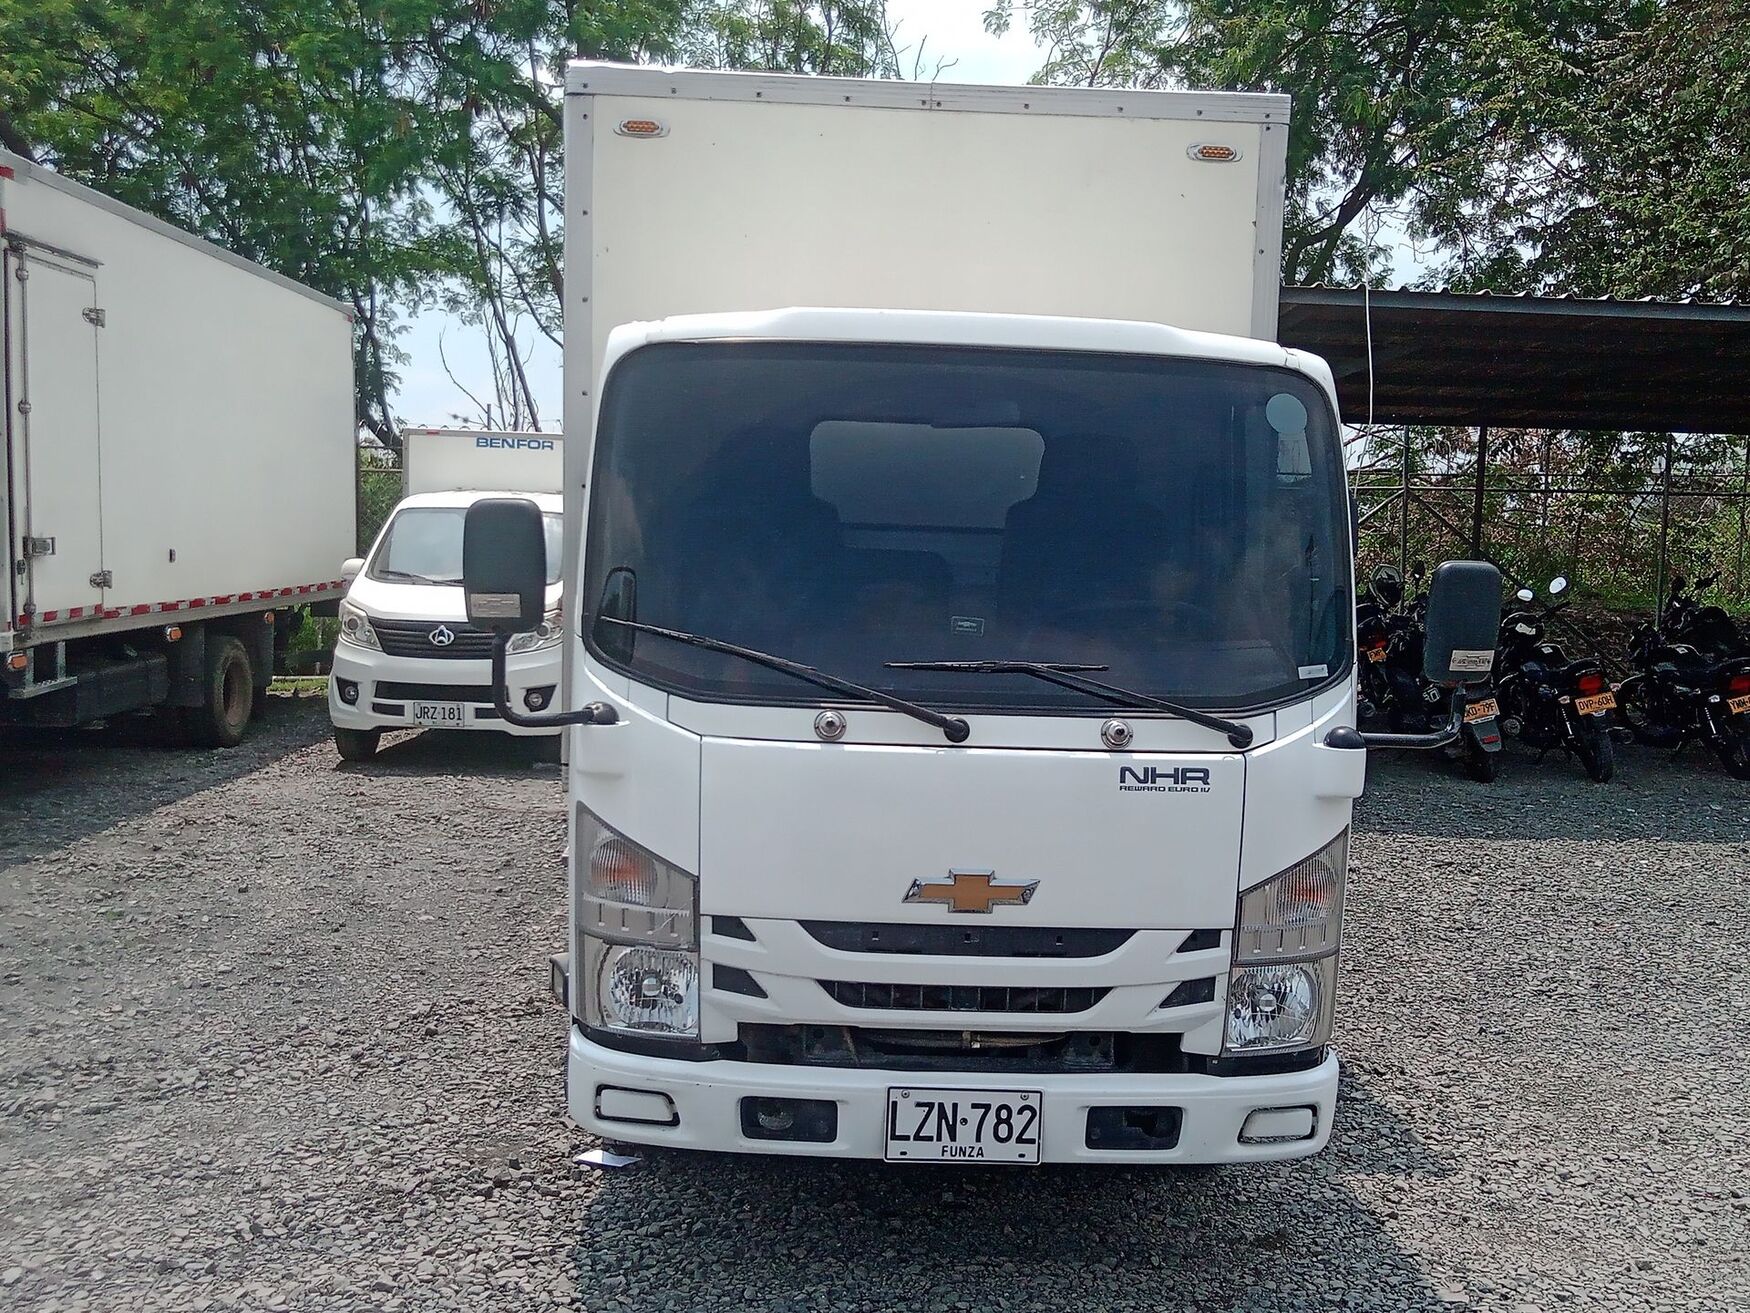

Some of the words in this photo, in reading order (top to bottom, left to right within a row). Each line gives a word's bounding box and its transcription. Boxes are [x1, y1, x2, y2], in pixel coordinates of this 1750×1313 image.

[476, 437, 554, 450] BENFOR
[415, 706, 438, 719] JRZ
[441, 706, 462, 720] 181
[1119, 766, 1210, 785] NHR
[889, 1100, 1038, 1145] LZN·782
[941, 1145, 985, 1158] FUNZA
